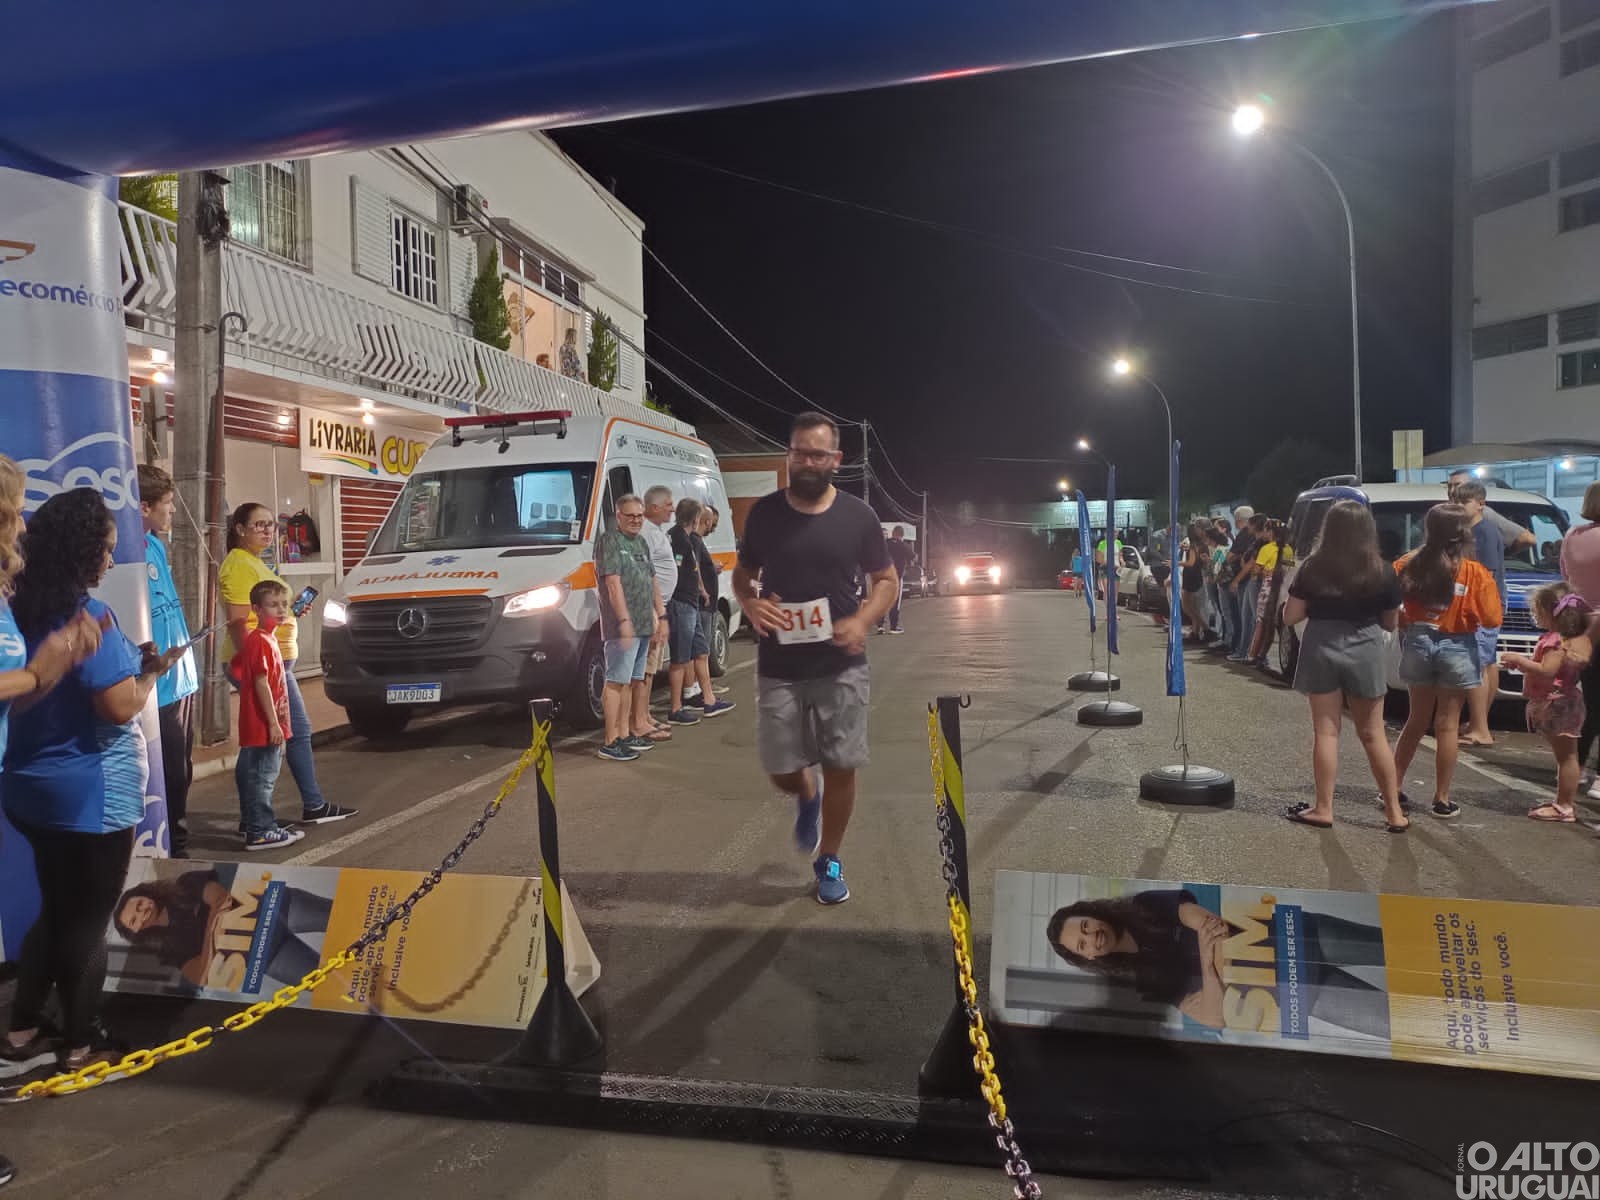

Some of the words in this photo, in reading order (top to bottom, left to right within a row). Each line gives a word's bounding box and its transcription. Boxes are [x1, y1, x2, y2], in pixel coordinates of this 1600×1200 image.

[782, 605, 825, 632] 314
[355, 933, 368, 962] too
[362, 886, 378, 929] mundo
[1433, 913, 1450, 964] mundo
[1449, 912, 1459, 929] os
[1465, 920, 1479, 956] Sesc.
[248, 959, 261, 990] TODOS
[255, 927, 268, 958] PODEM
[262, 910, 273, 926] SER
[358, 970, 370, 1003] pode
[379, 884, 388, 899] os
[388, 936, 406, 991] Inclusive
[1286, 937, 1296, 957] SER
[1493, 931, 1511, 969] você.
[1288, 959, 1298, 997] PODEM
[1440, 969, 1455, 1004] todo
[1452, 933, 1472, 1009] aproveitar
[1468, 961, 1483, 981] do
[1289, 998, 1300, 1034] TODOS
[1473, 985, 1489, 1049] serviços
[1500, 974, 1520, 1042] Inclusive
[1445, 1010, 1459, 1050] Aqui,
[1459, 1014, 1476, 1055] pode
